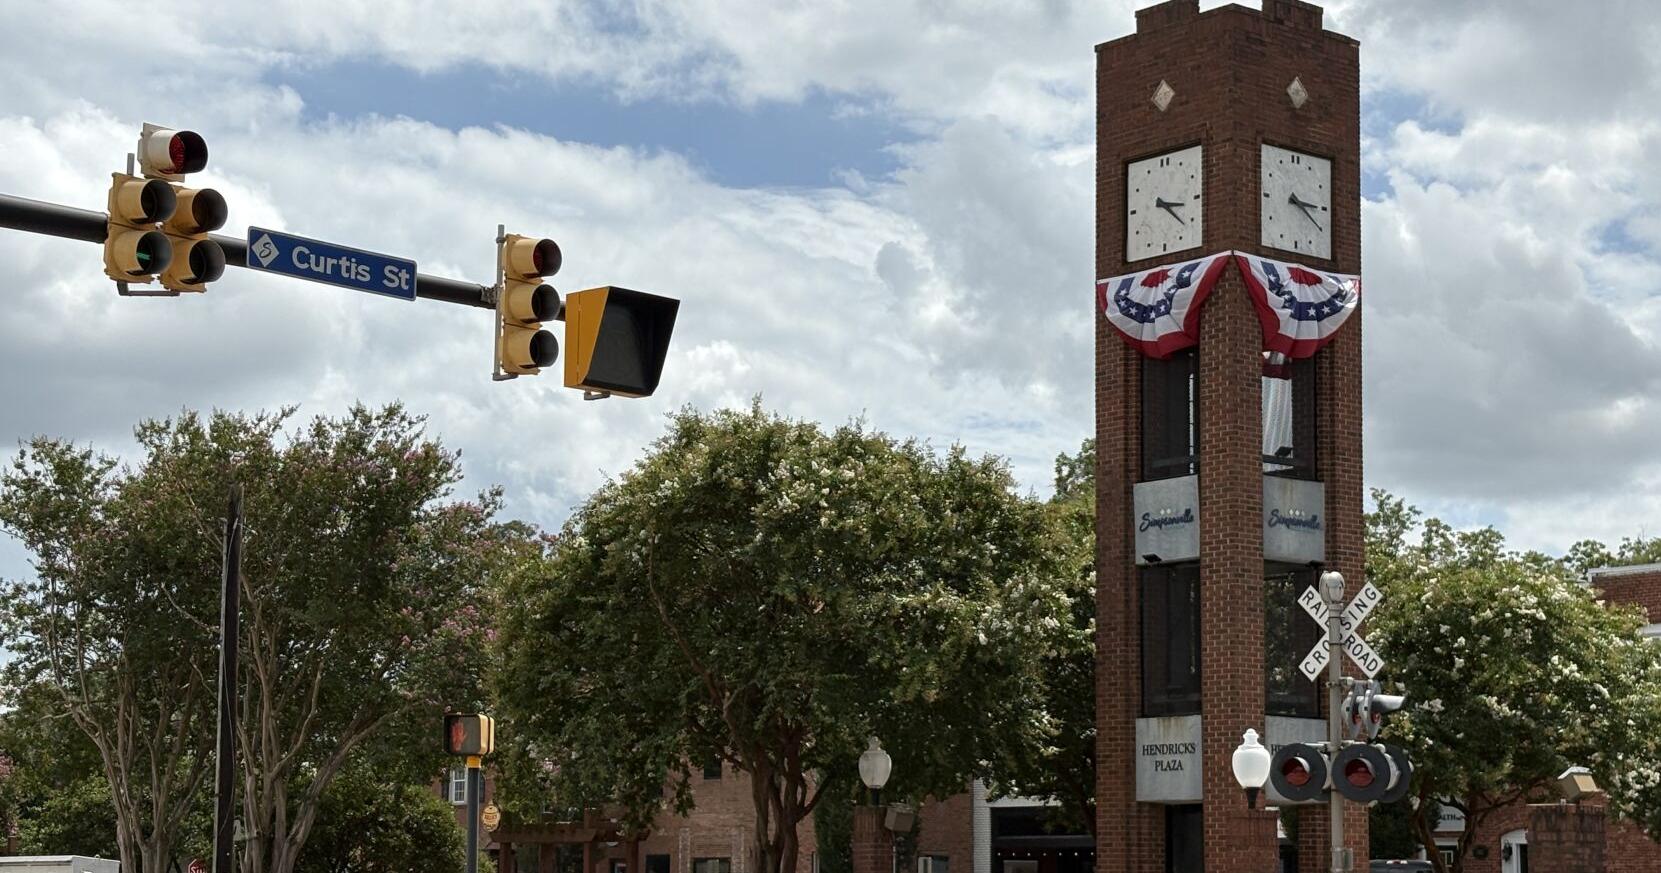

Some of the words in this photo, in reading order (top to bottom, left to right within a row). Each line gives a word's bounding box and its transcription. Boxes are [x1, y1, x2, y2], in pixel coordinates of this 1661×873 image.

[292, 246, 371, 282] Curtis
[382, 265, 410, 290] St
[1139, 508, 1195, 533] Simpsonville
[1142, 743, 1196, 756] HENDRICKS
[1154, 760, 1184, 772] PLAZA
